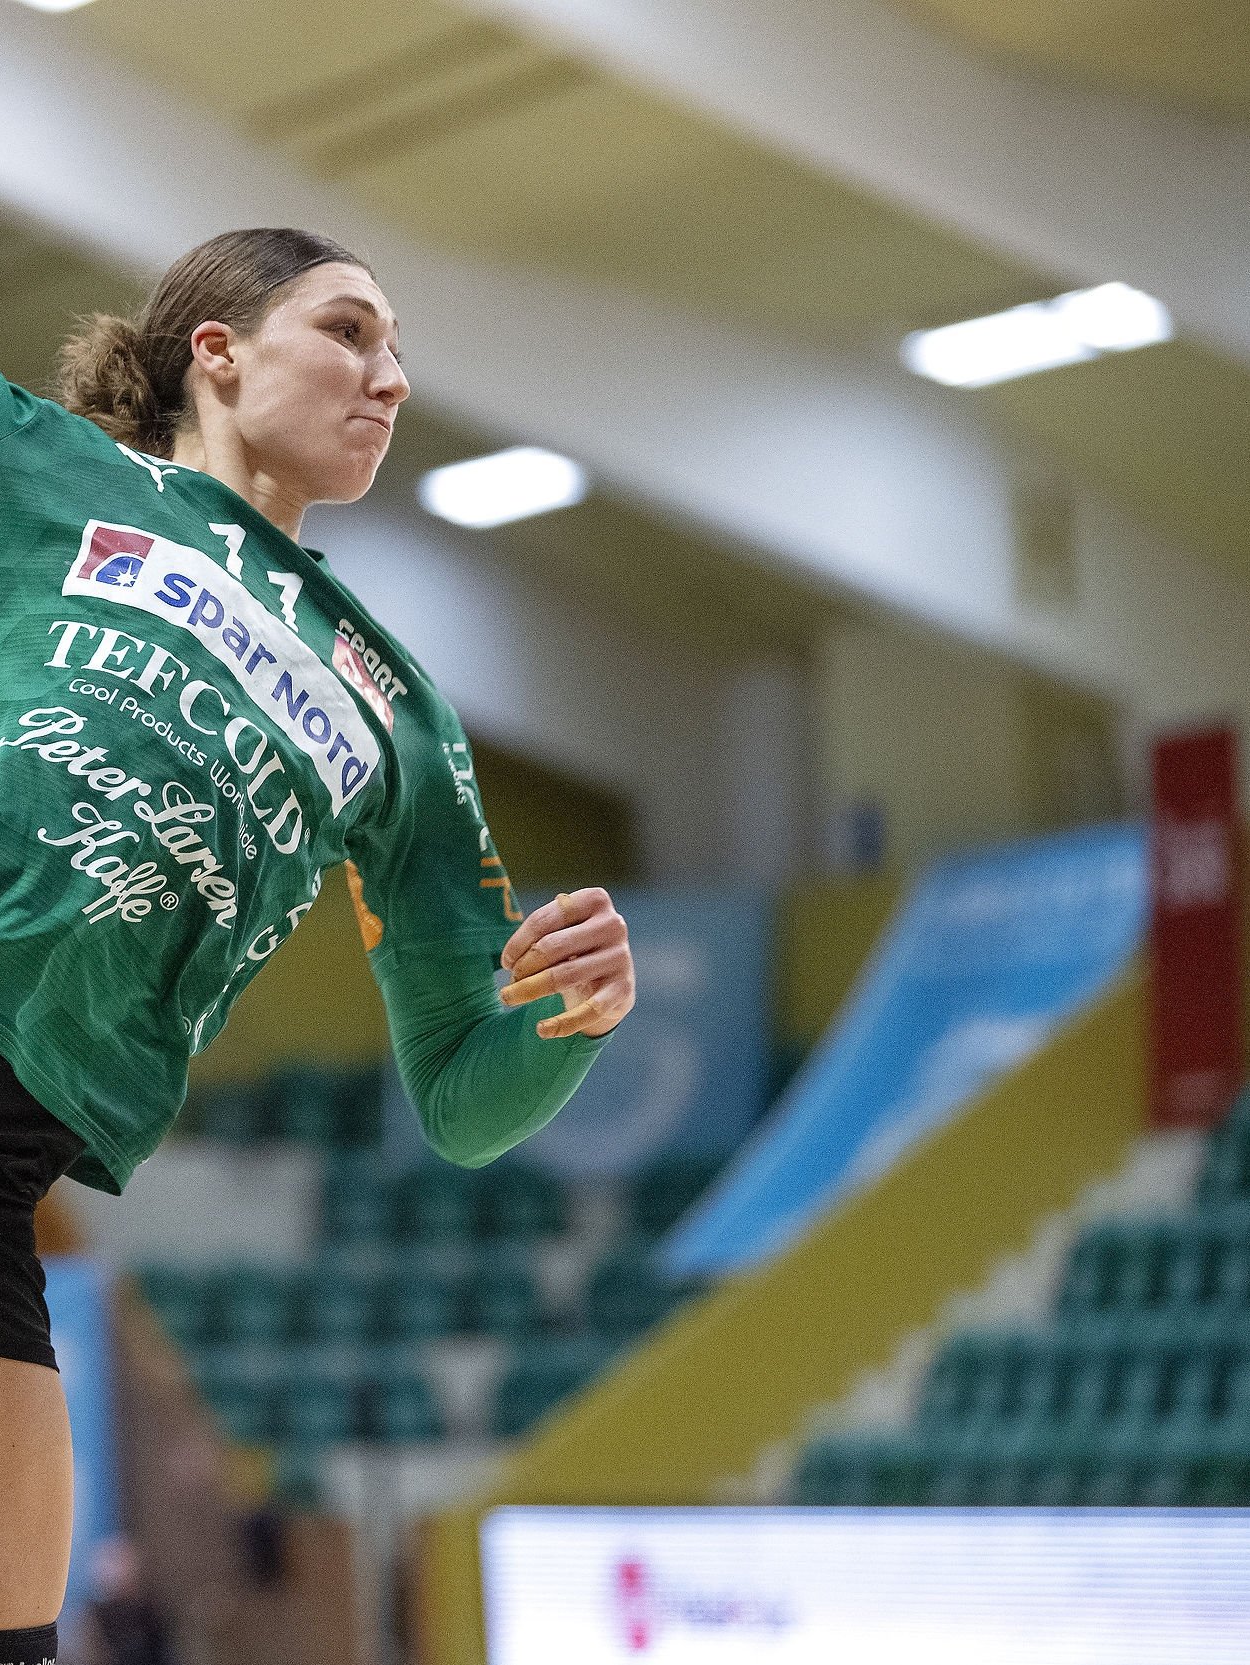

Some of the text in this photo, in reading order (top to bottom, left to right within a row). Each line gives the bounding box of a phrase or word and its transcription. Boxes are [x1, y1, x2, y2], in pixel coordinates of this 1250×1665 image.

[44, 620, 303, 855] TEFCOLD
[68, 678, 119, 705] Cool
[118, 696, 208, 767] Products
[154, 572, 277, 674] spar
[271, 670, 369, 797] Nord
[134, 782, 238, 929] Larsen
